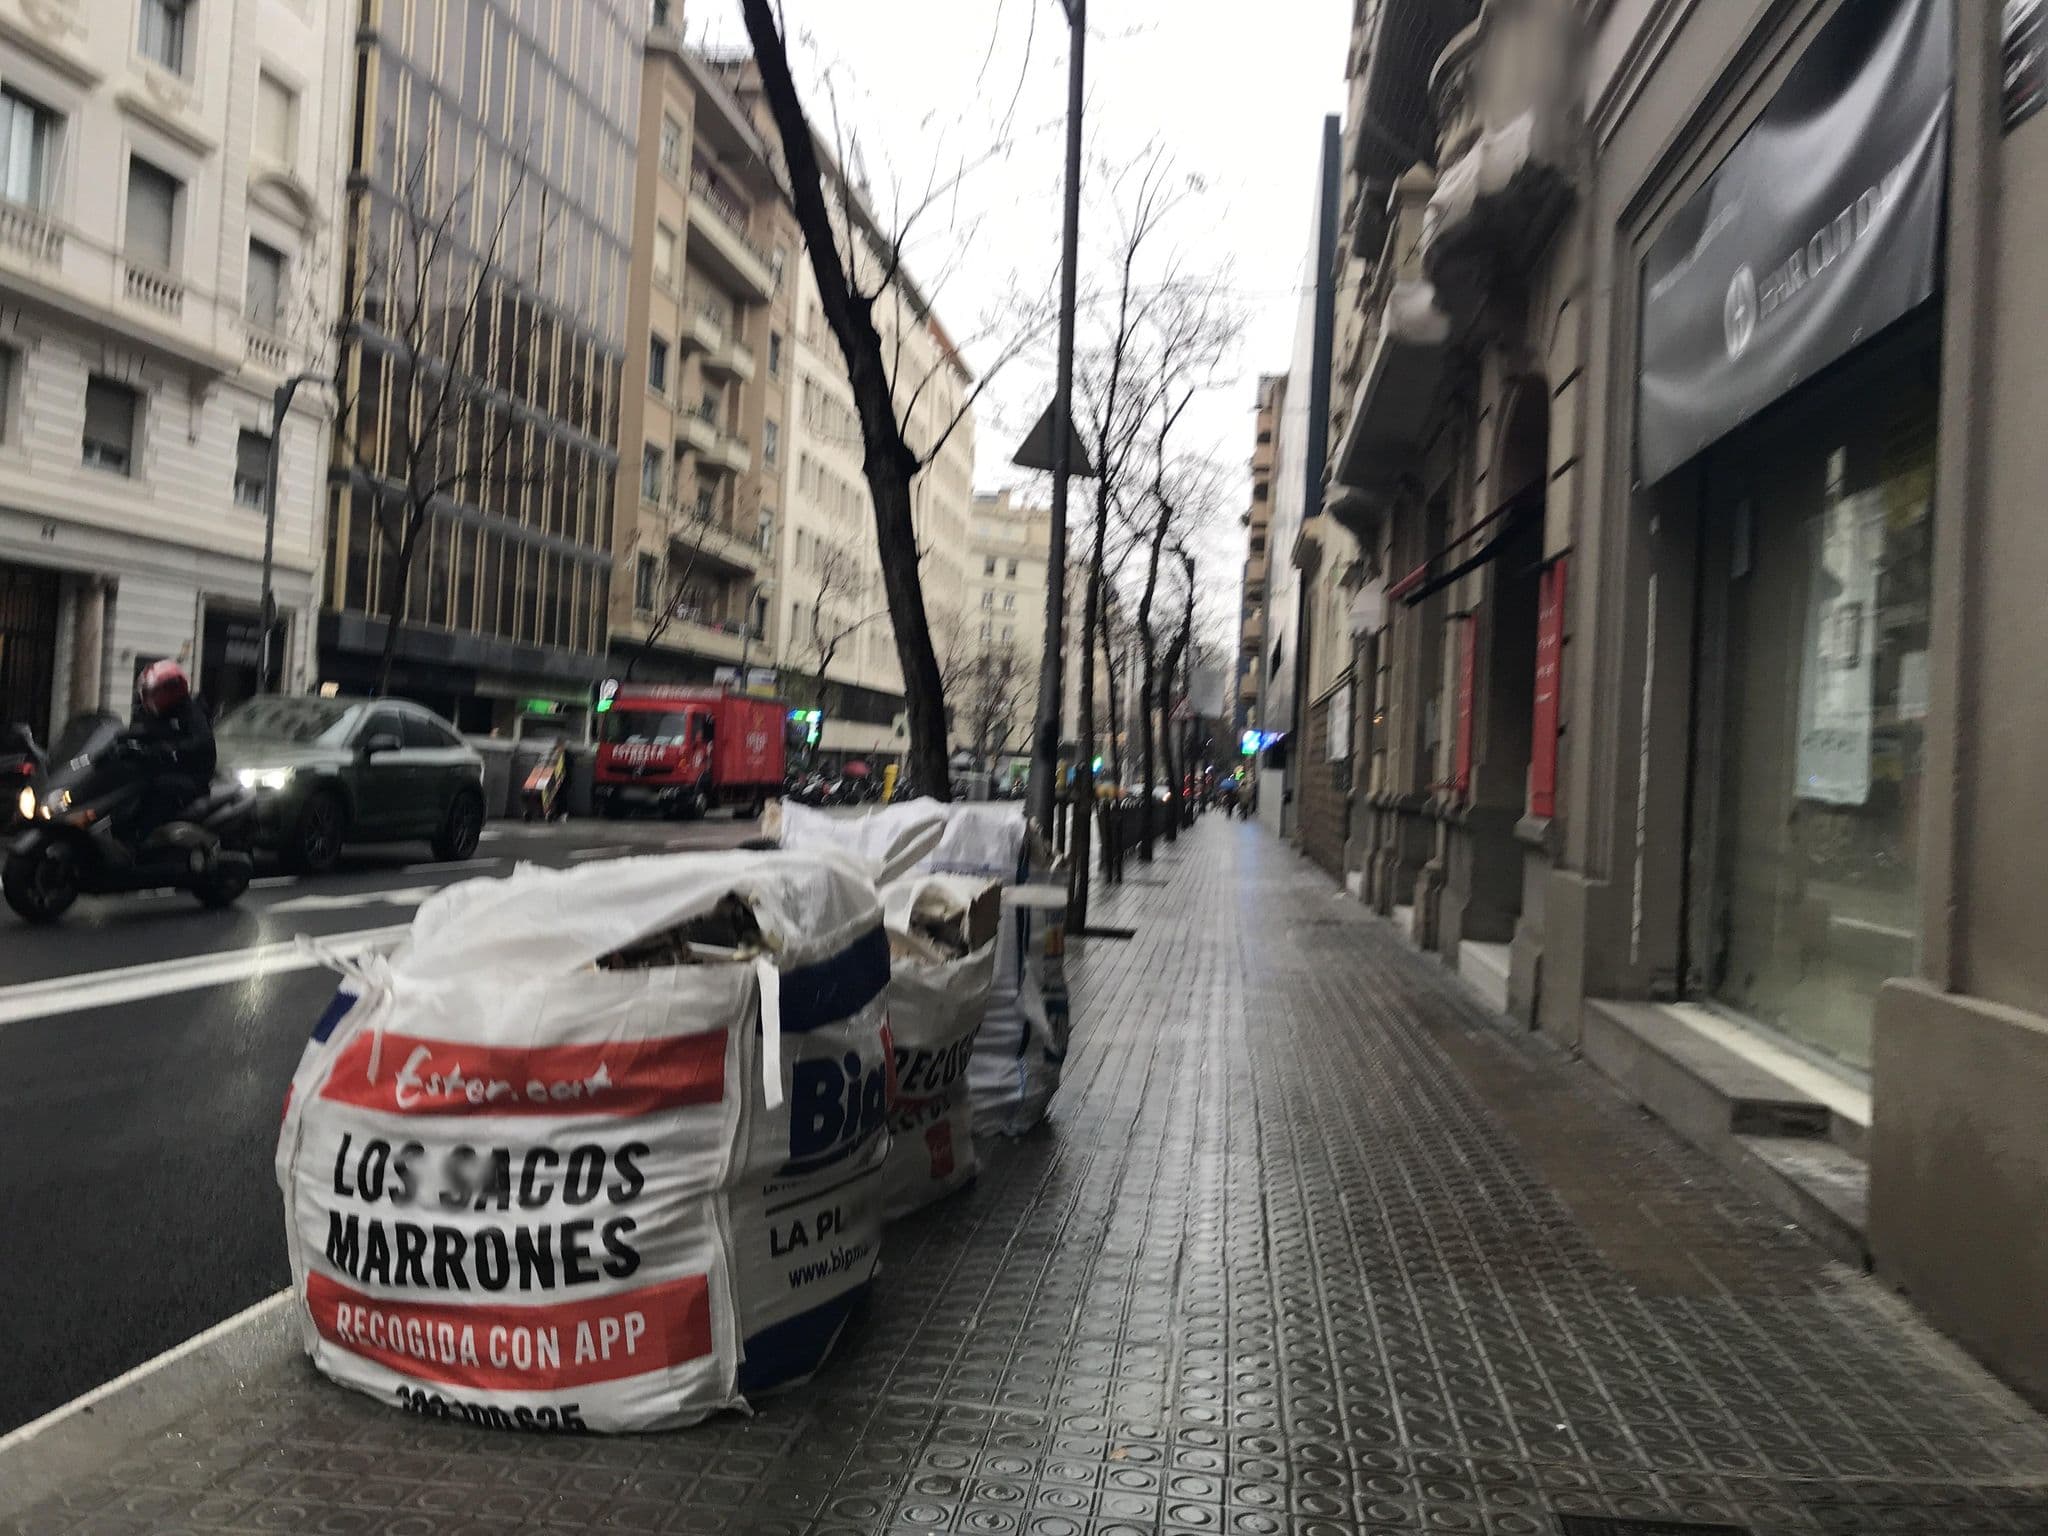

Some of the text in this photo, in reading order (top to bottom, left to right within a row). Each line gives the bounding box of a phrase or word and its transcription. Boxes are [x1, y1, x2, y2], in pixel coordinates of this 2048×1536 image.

[333, 1133, 651, 1212] LOS SACOS
[326, 1208, 642, 1293] MARRONES
[769, 1218, 809, 1259] LA
[335, 1300, 647, 1371] RECOGIDA CON APP
